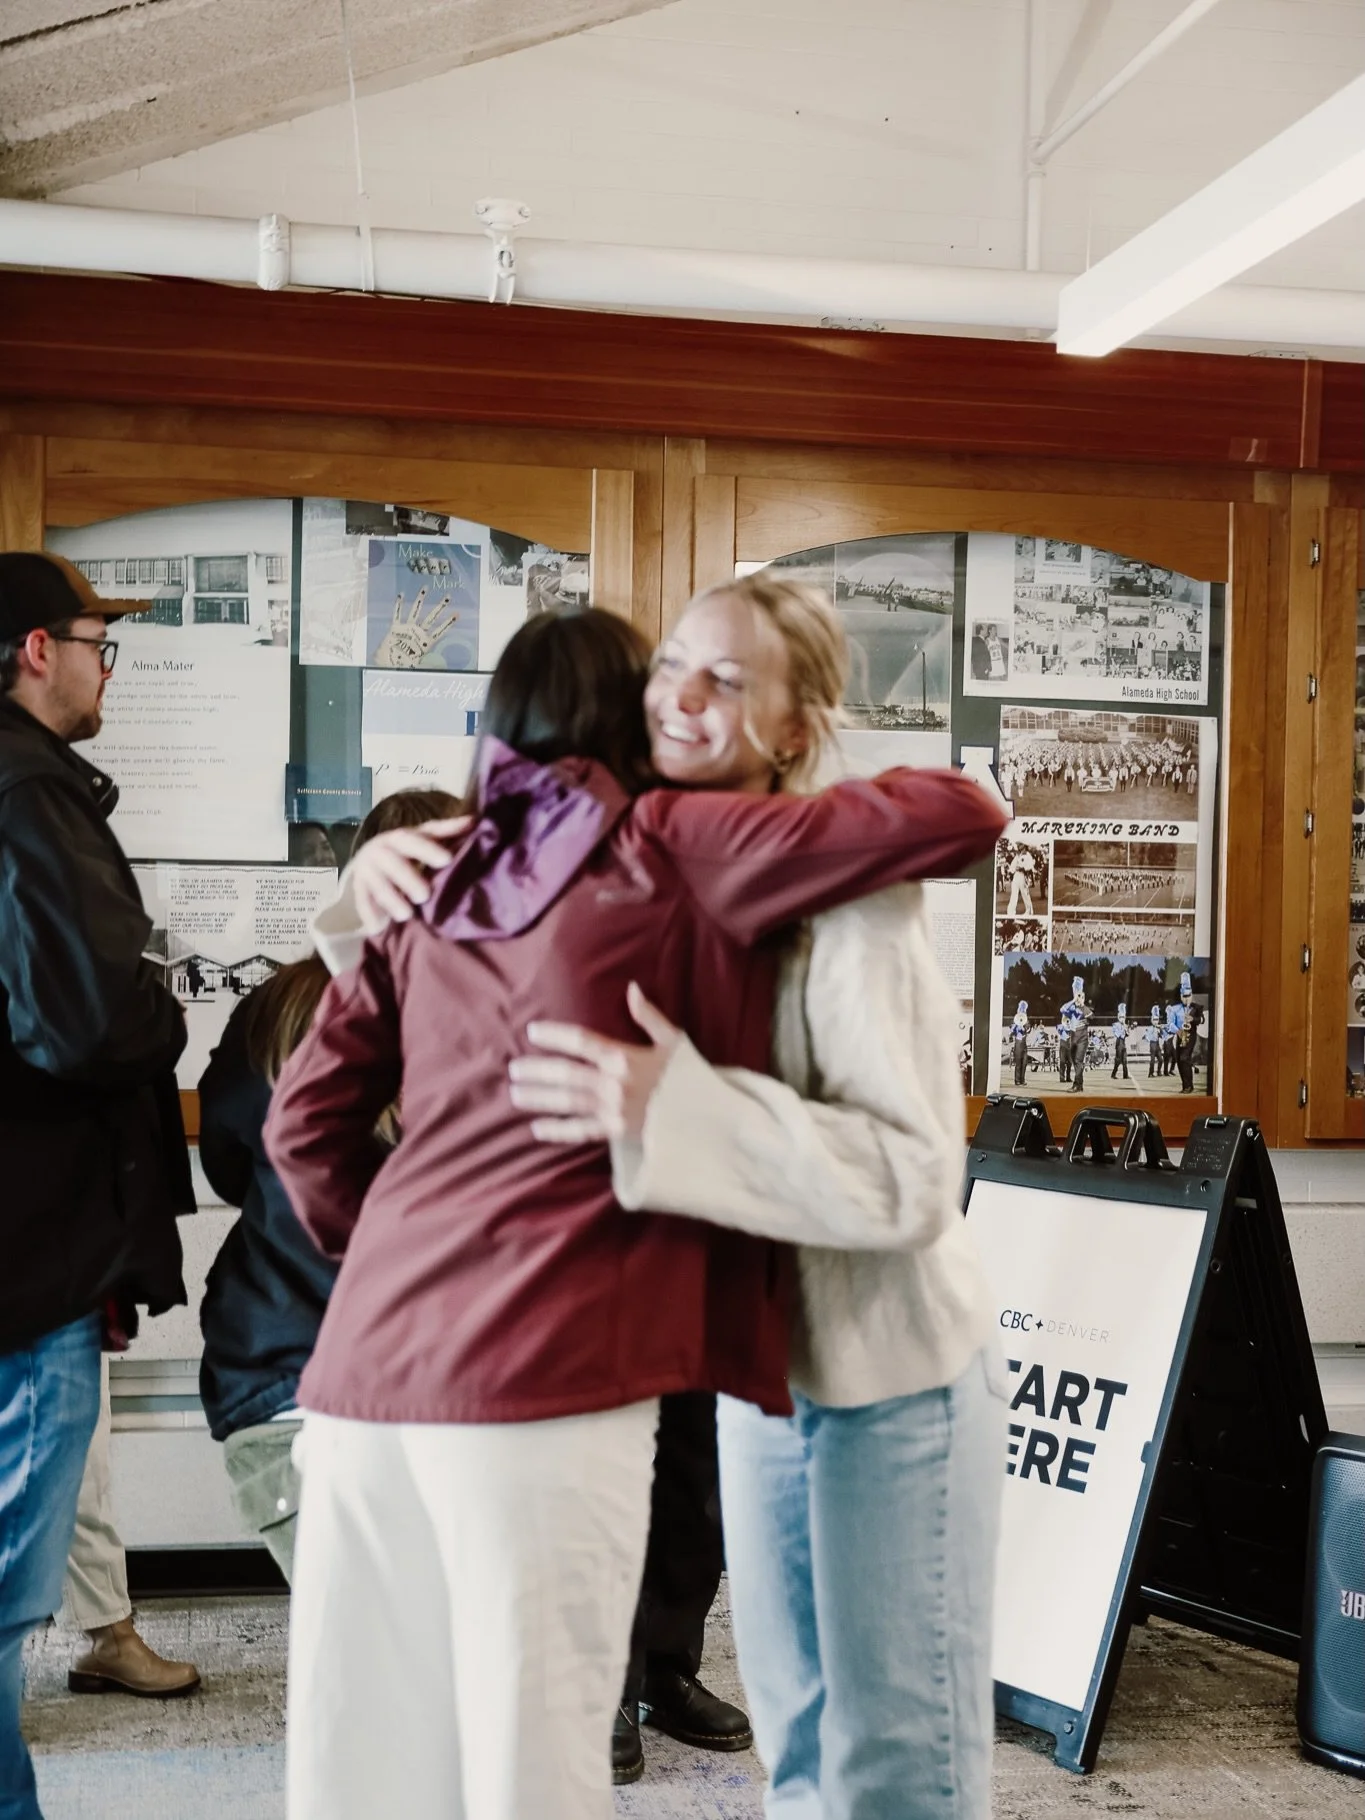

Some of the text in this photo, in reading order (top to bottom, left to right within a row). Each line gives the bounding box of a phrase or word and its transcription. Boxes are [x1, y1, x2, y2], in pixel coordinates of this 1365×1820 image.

[398, 543, 434, 558] Make
[432, 575, 465, 590] Mark
[131, 659, 195, 672] Alma Mater
[366, 678, 485, 710] Alameda High
[1121, 685, 1200, 701] Alameda High School
[1021, 821, 1180, 837] MARCHING BAND
[1000, 1309, 1110, 1344] CBC DENVER
[1006, 1358, 1128, 1431] ART
